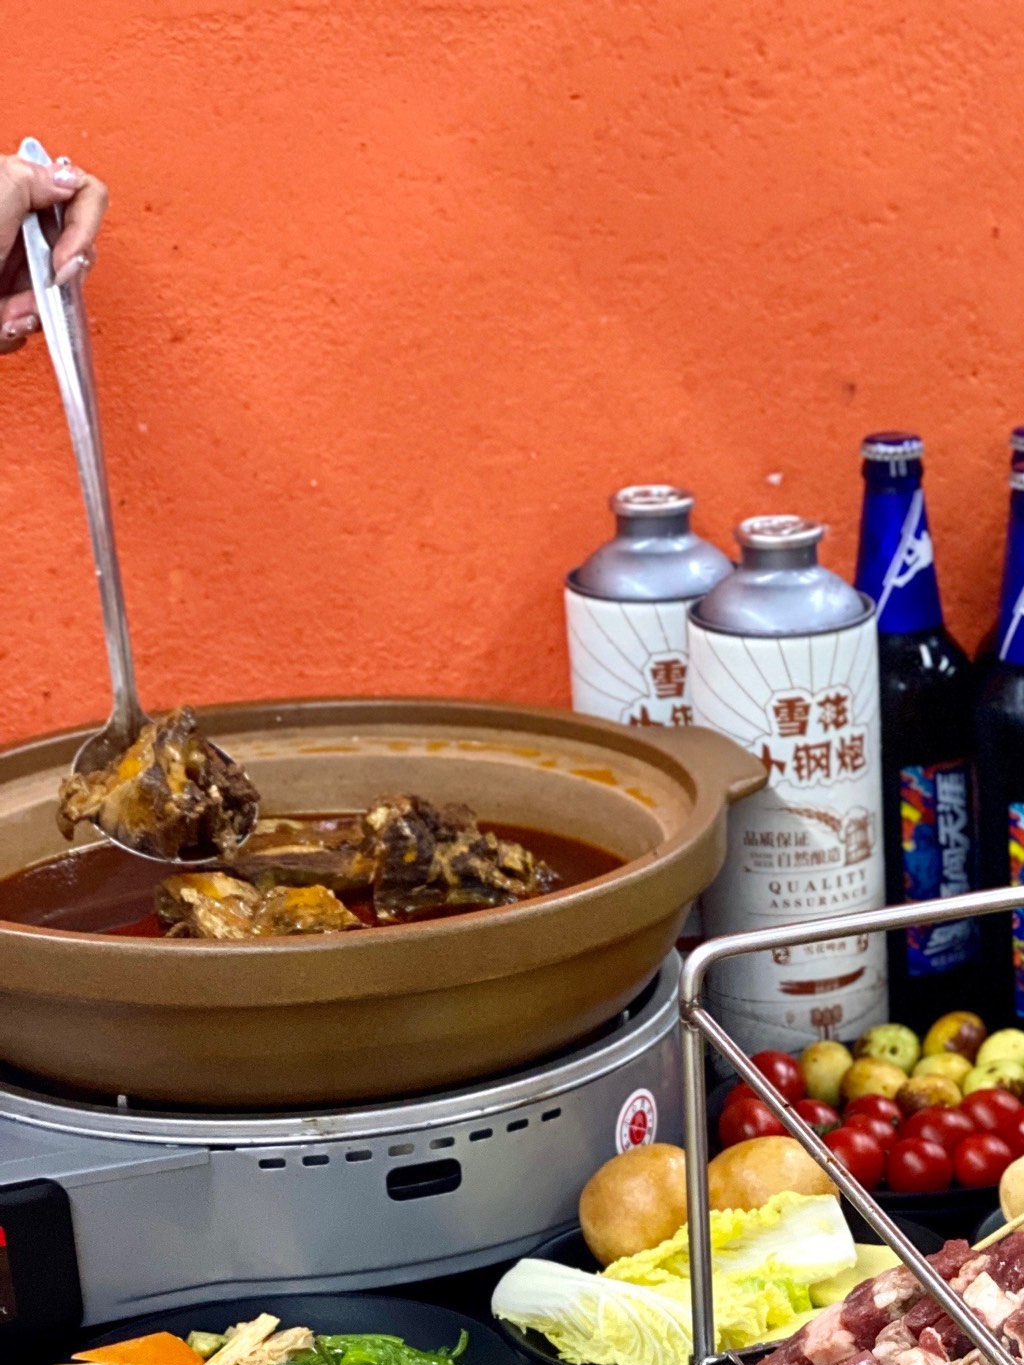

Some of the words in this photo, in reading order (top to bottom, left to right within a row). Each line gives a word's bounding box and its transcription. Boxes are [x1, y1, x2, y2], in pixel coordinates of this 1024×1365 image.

[650, 658, 687, 699] 雪
[773, 692, 849, 737] 雪花
[743, 830, 808, 848] 品质保证
[768, 868, 866, 895] QUALITY
[769, 885, 867, 909] ASSURANCE
